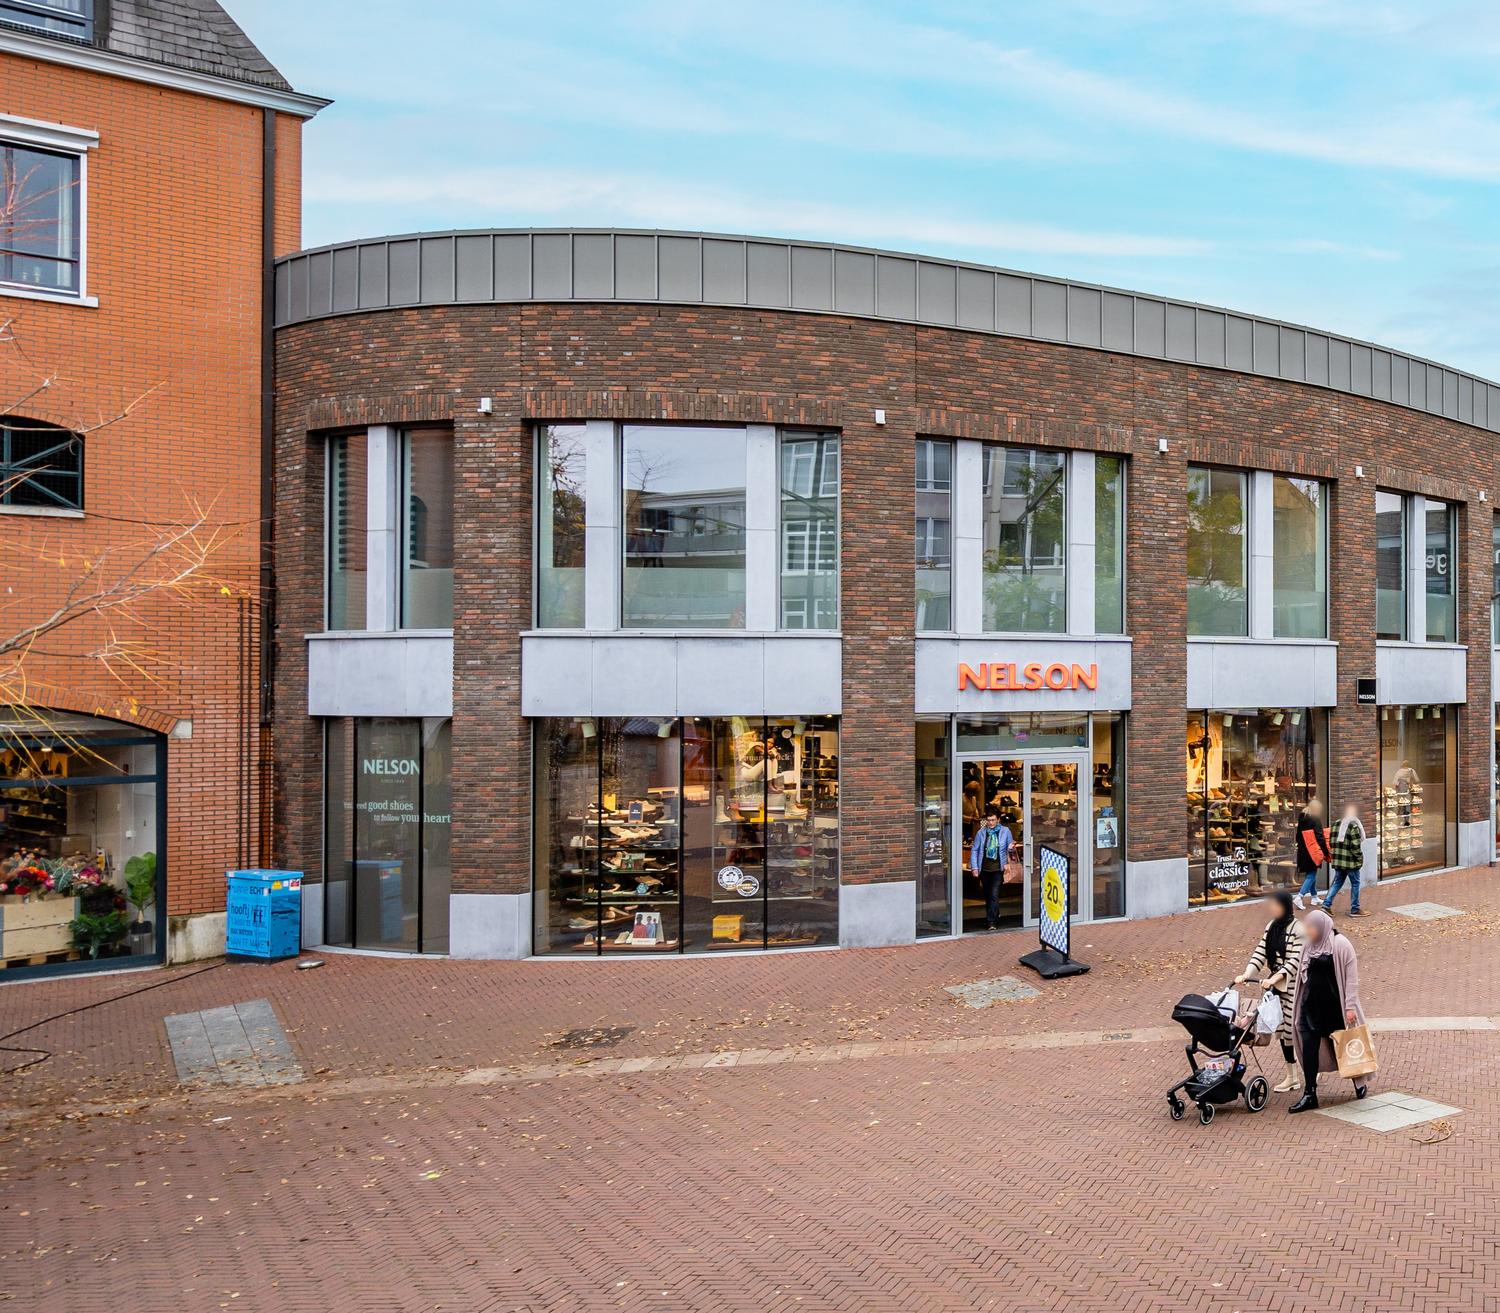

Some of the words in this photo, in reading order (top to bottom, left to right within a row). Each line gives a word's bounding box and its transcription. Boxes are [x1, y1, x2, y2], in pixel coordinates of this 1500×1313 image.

[959, 663, 1098, 690] NELSON
[363, 759, 420, 775] NELSON
[368, 801, 388, 812] good
[390, 800, 414, 811] shoes
[423, 813, 452, 823] heart
[1209, 864, 1249, 878] classics
